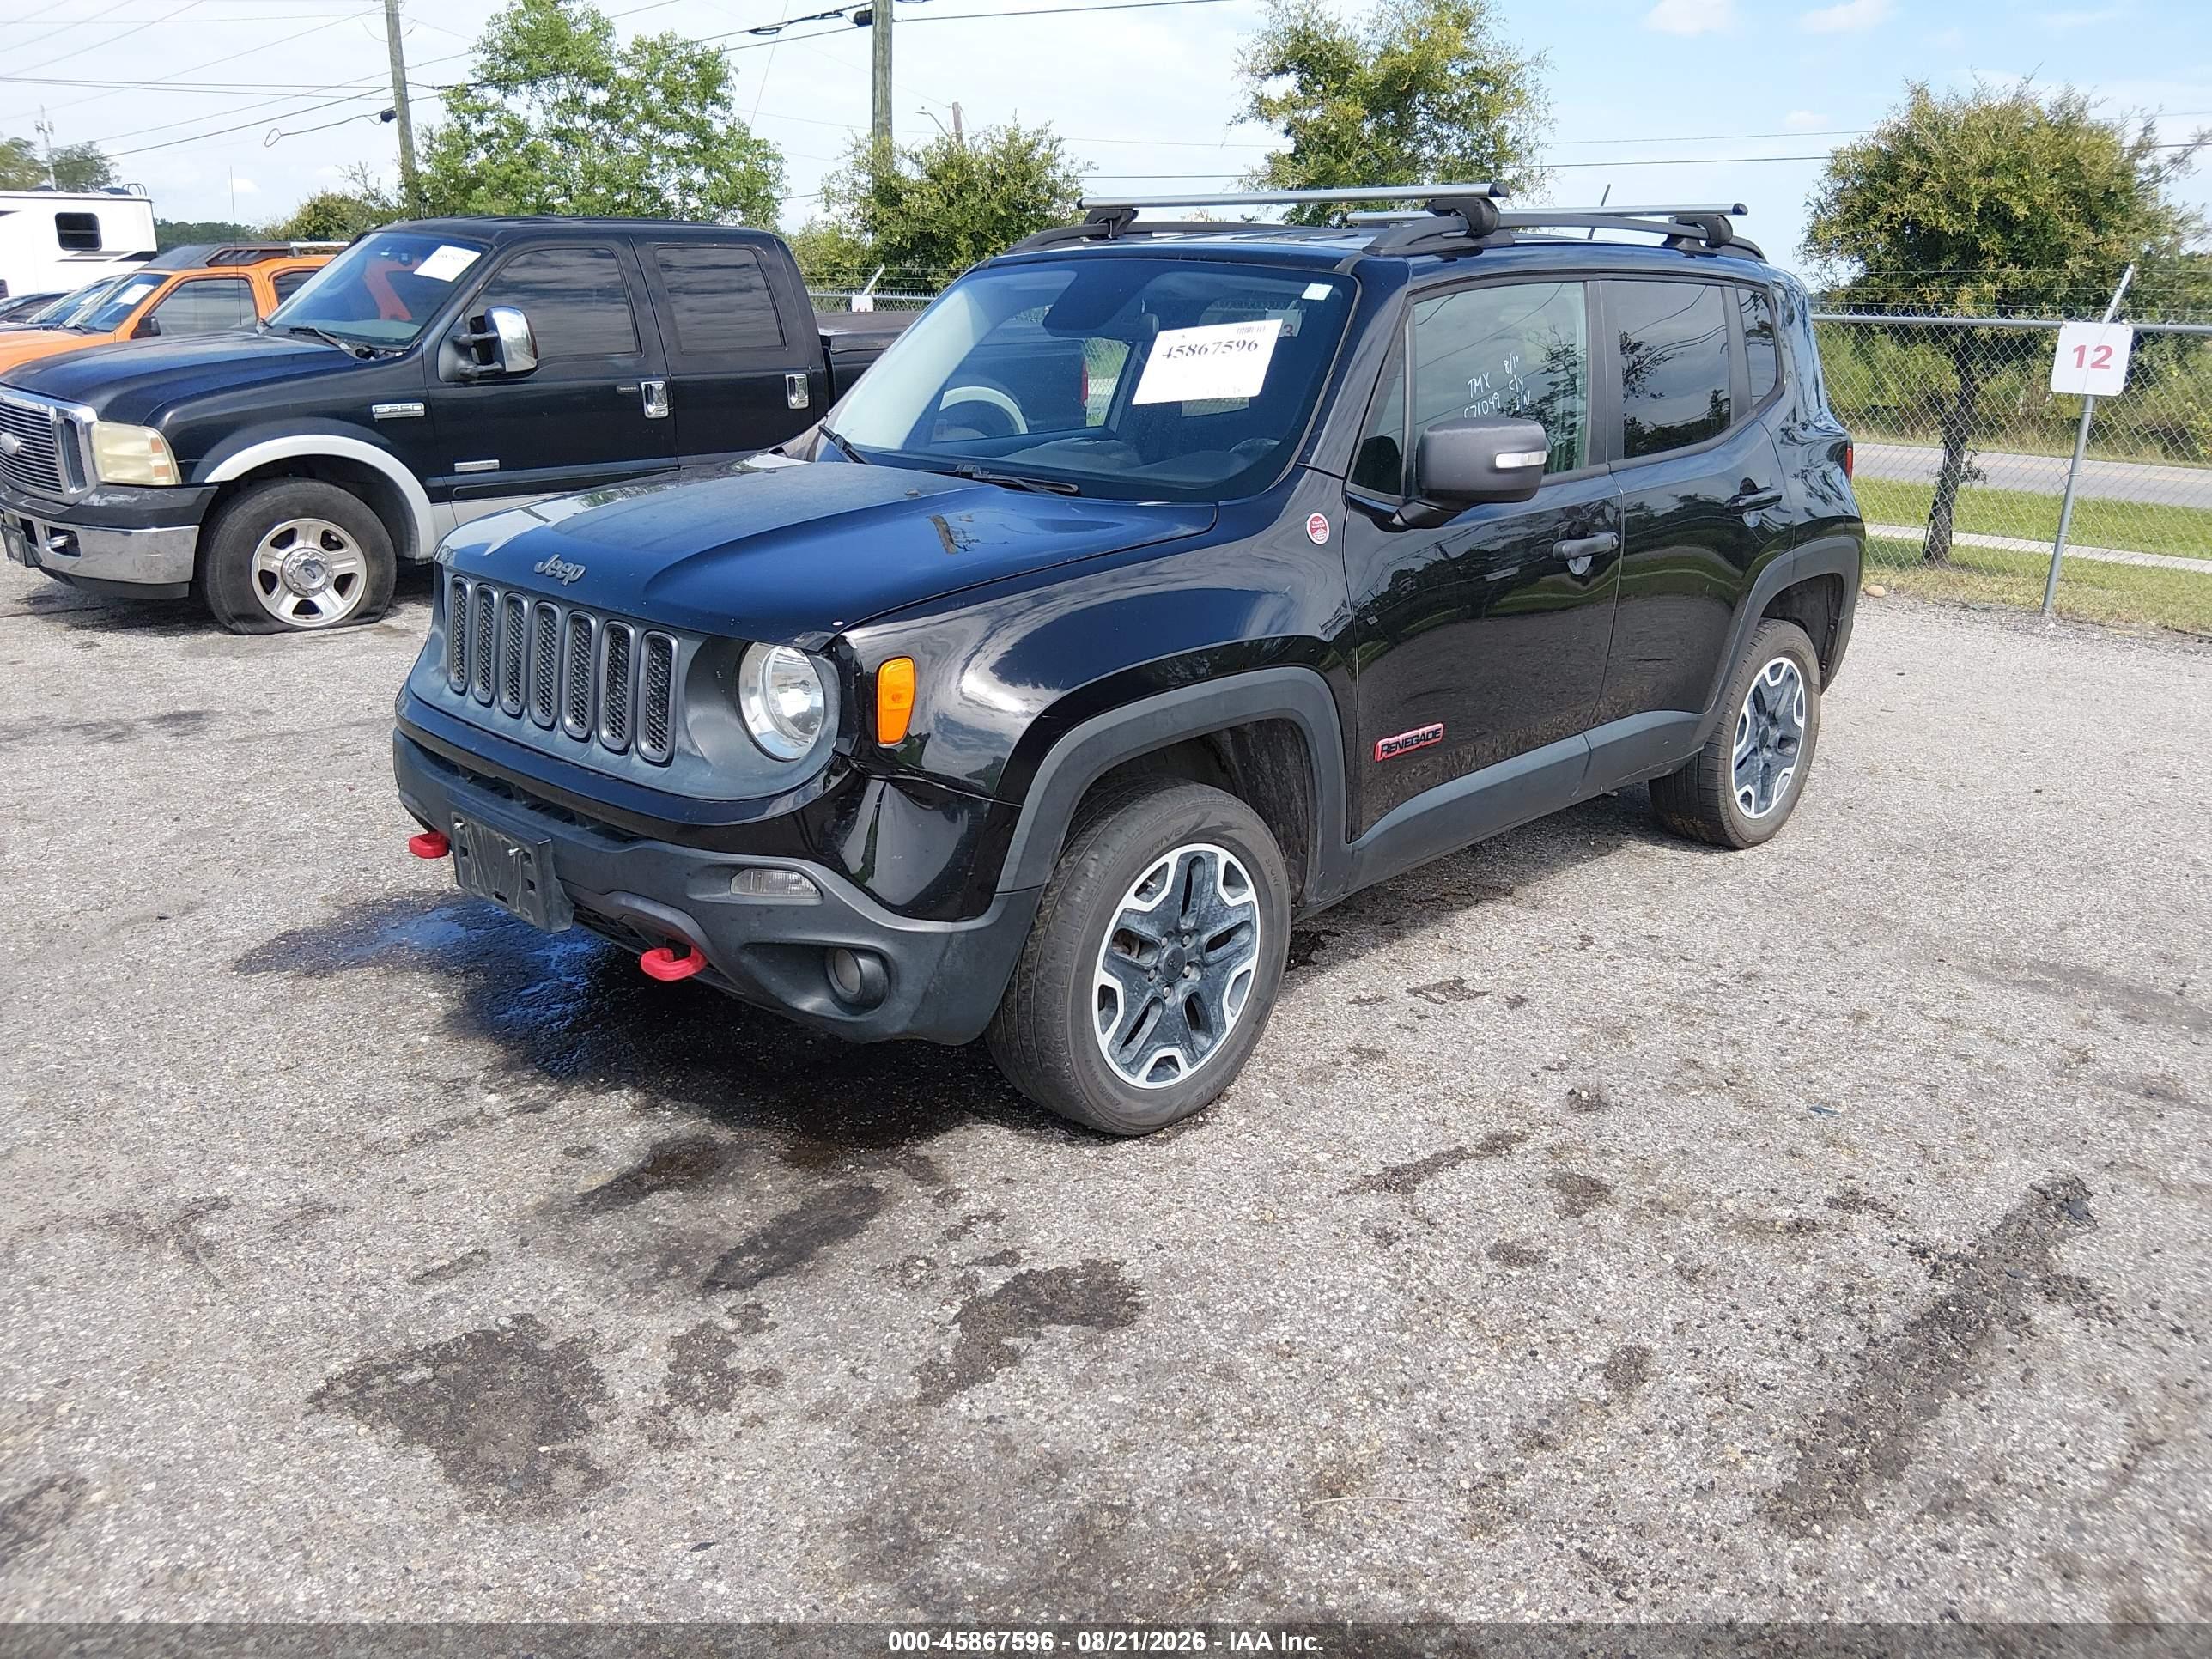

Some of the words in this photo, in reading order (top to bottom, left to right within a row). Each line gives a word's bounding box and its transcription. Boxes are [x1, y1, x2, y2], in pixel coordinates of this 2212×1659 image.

[1162, 338, 1259, 360] 45867596
[2073, 344, 2113, 369] 12
[1467, 372, 1491, 399] TMX
[534, 553, 586, 586] Jeep
[1380, 726, 1443, 756] RENEGADE
